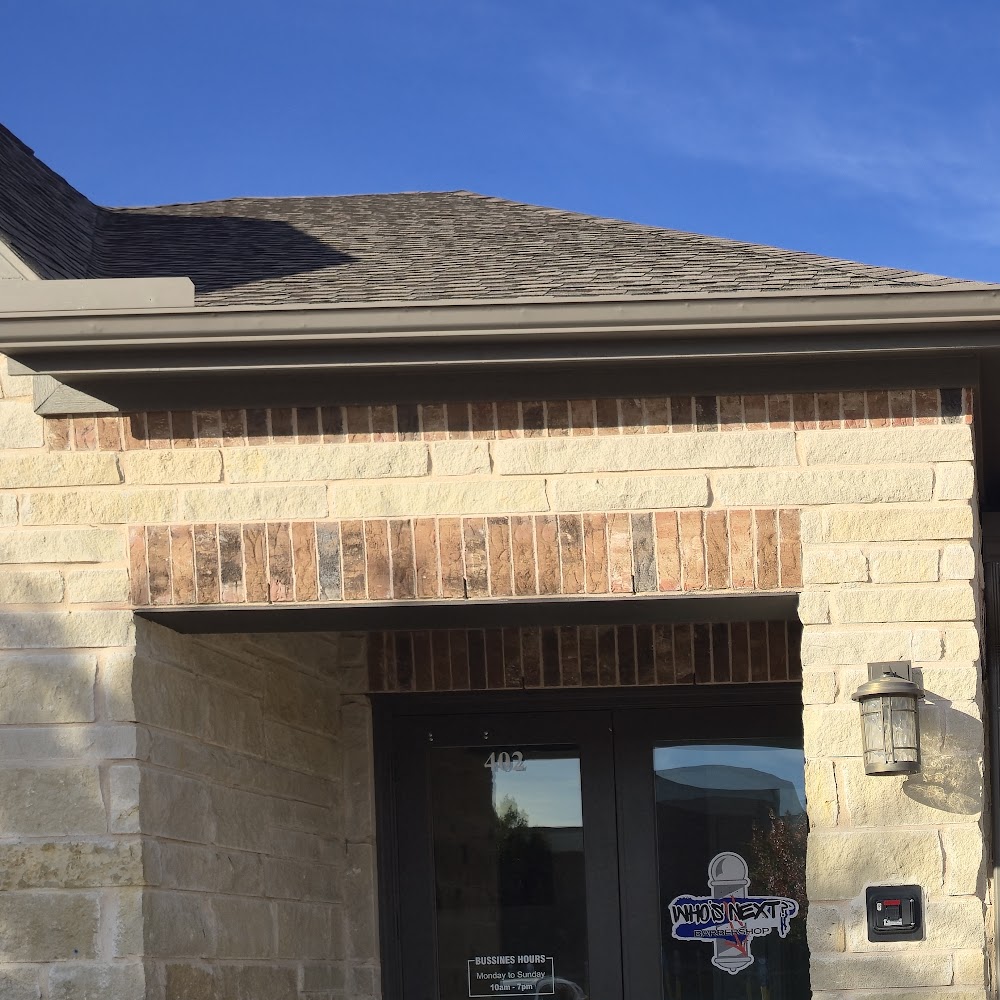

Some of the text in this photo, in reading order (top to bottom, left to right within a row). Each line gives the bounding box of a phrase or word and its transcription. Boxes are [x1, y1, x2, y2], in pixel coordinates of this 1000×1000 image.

[484, 751, 526, 772] 402
[672, 900, 788, 923] WHO'S NEXT?
[694, 927, 770, 937] BARBERSHOP
[475, 954, 546, 965] BUSSINES HOURS
[476, 970, 546, 980] Monday to Sunday
[490, 983, 511, 991] 10am
[517, 983, 533, 991] 7pm
